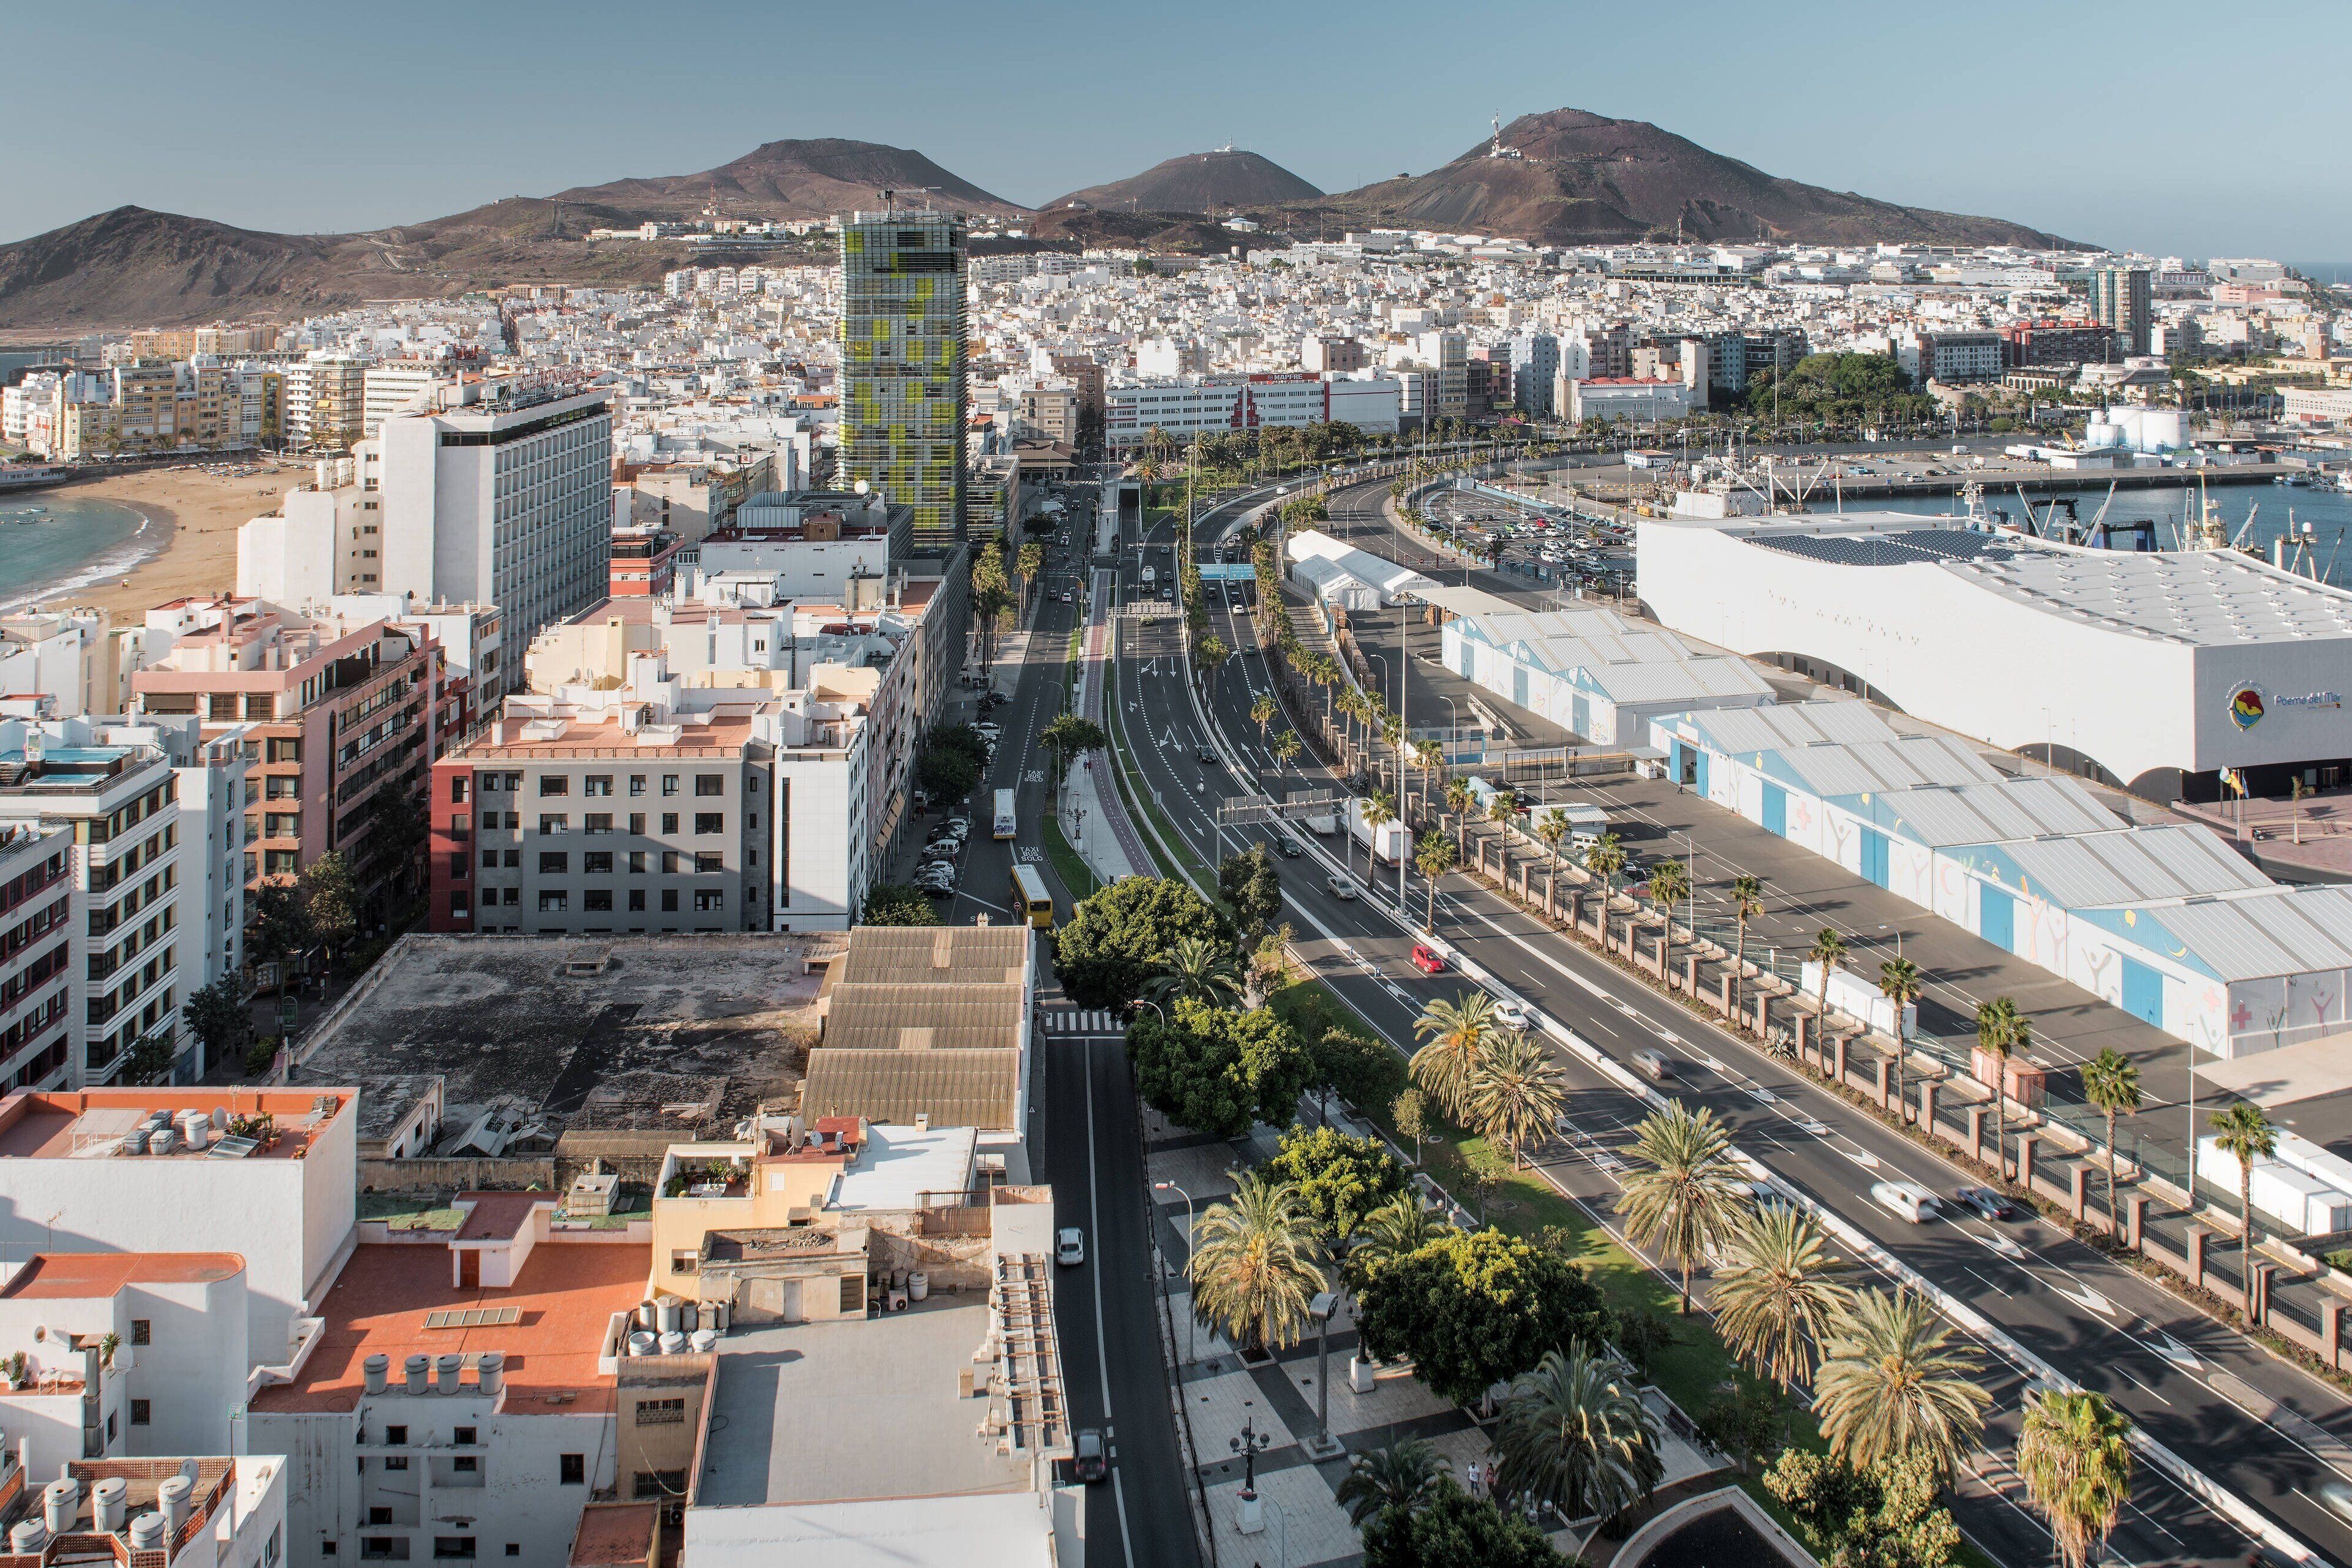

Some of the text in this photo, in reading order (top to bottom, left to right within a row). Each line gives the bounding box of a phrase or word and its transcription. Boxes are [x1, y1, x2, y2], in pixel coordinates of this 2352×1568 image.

[2274, 692, 2342, 706] Poema del Mar
